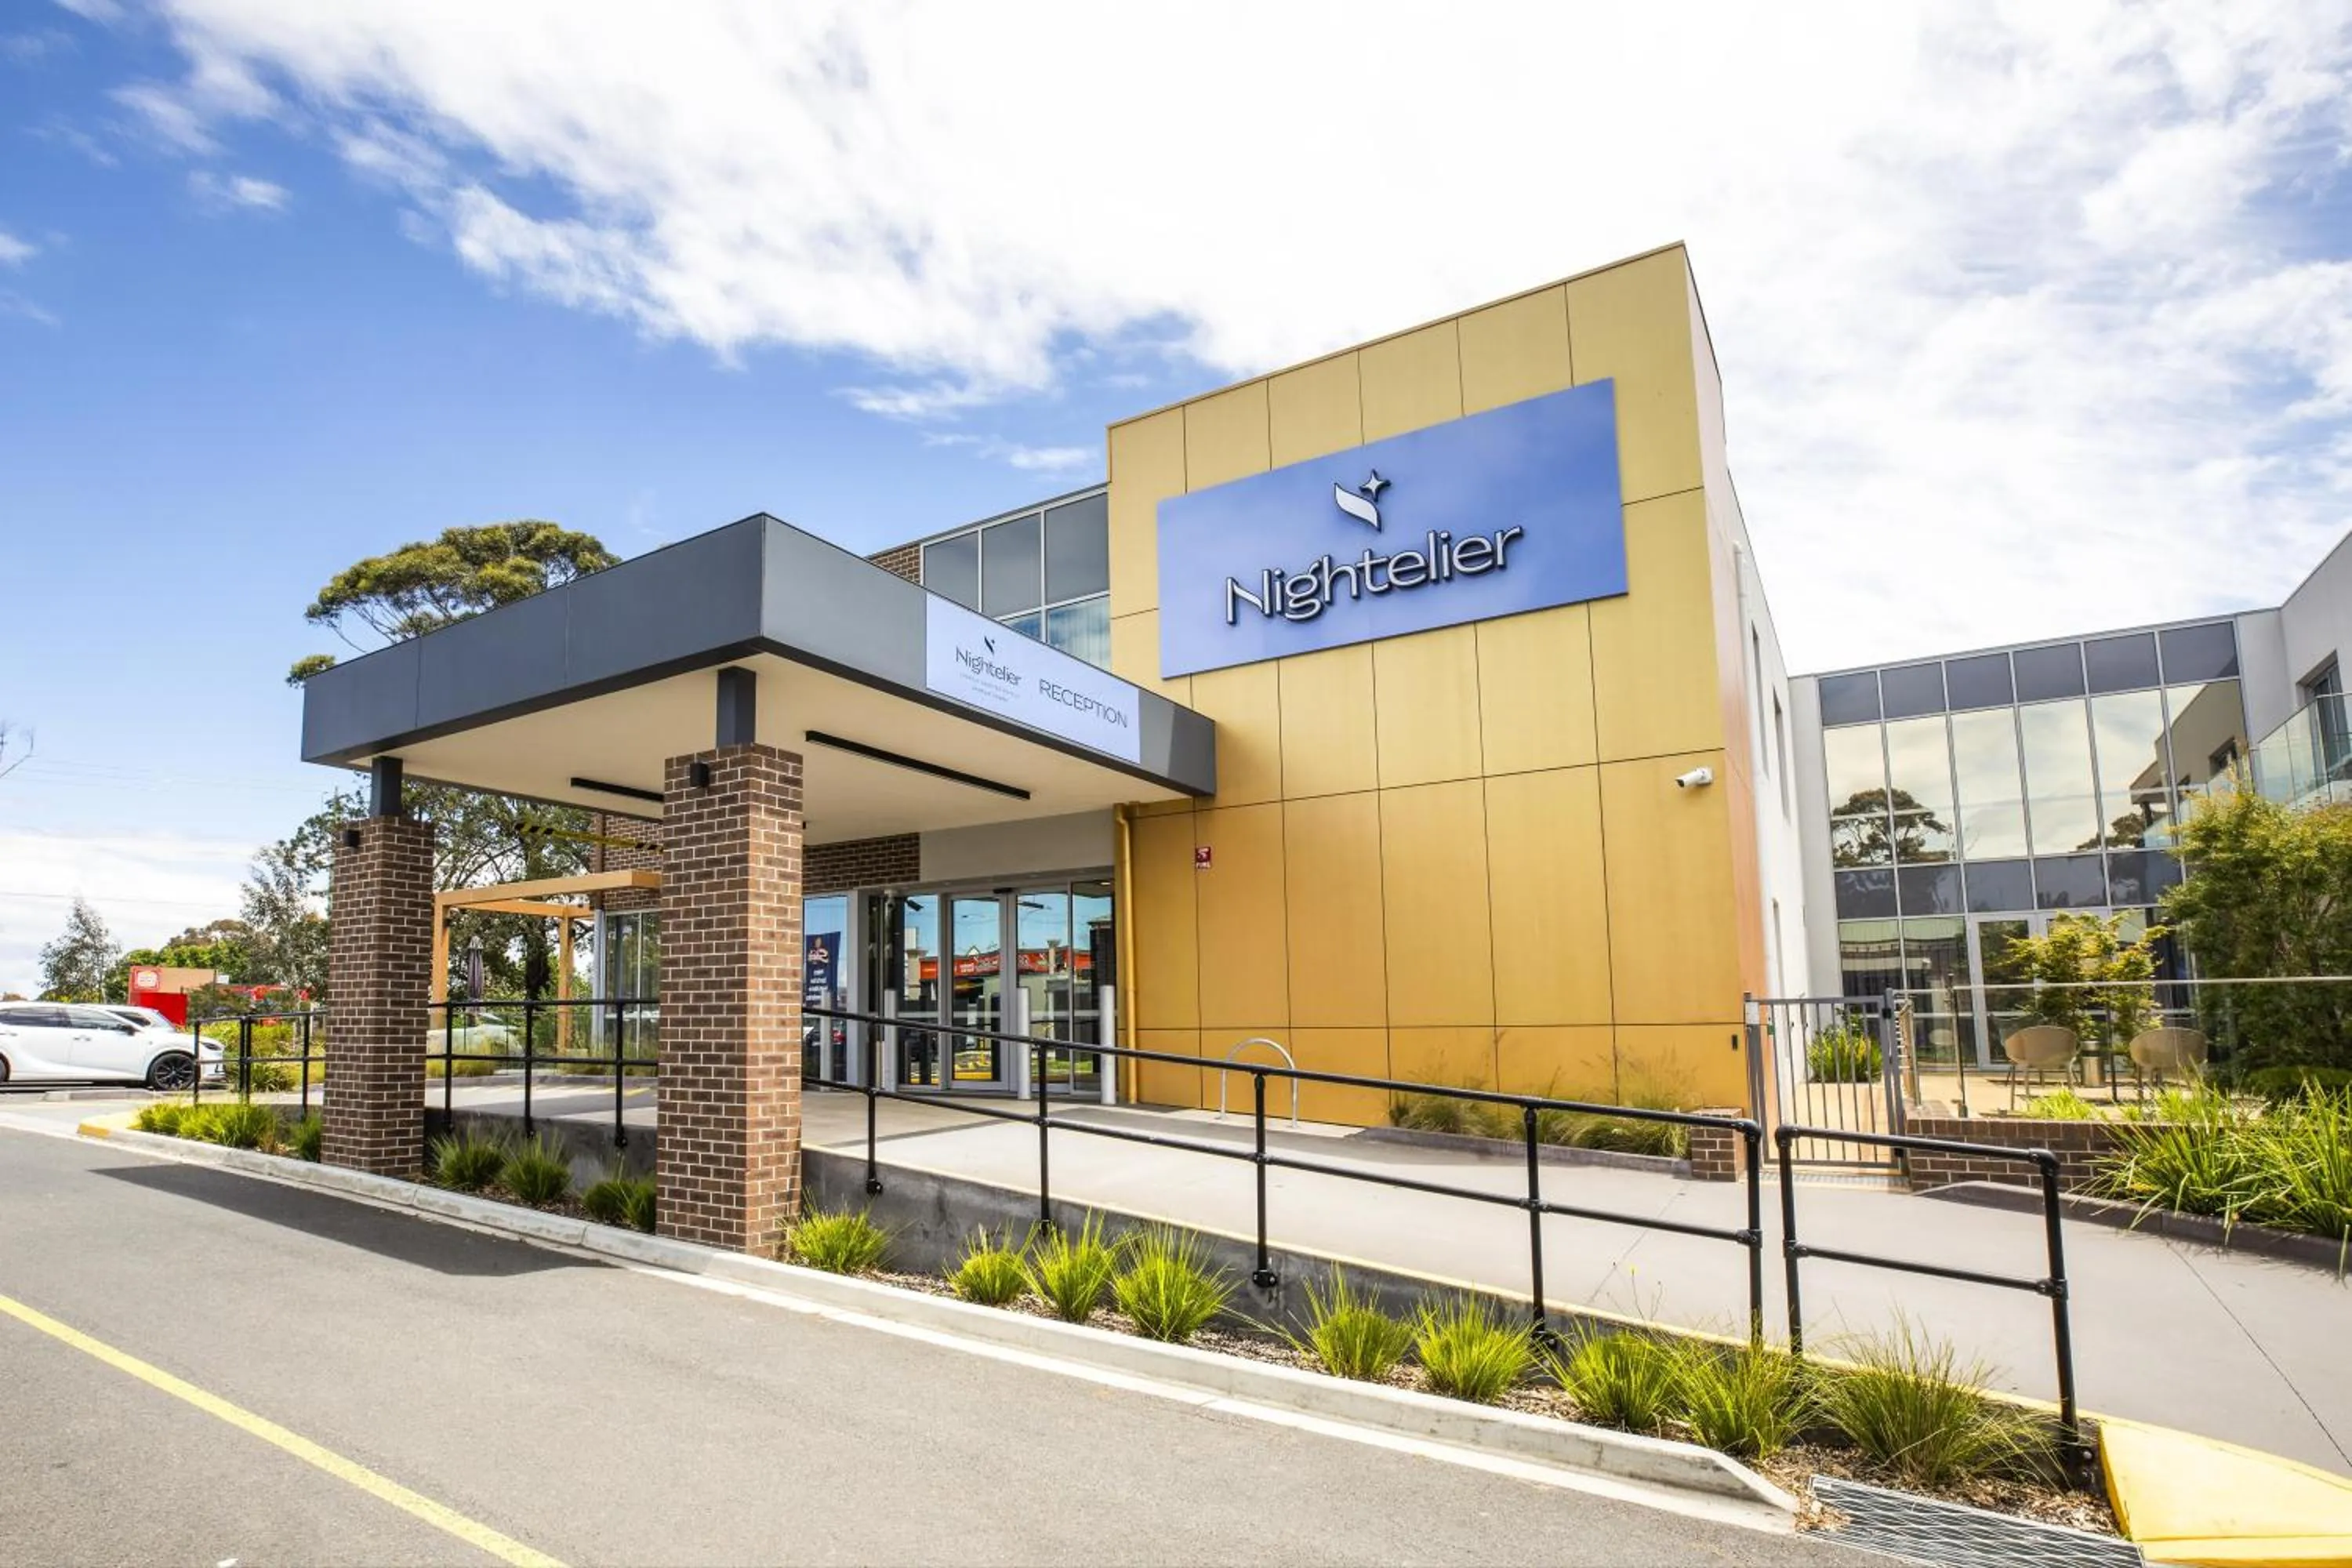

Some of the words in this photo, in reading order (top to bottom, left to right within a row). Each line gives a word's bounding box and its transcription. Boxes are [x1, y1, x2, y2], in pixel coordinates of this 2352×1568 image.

[1225, 525, 1523, 626] Nightelier
[956, 646, 1022, 685] Nightelier
[1039, 678, 1127, 728] RECEPTION
